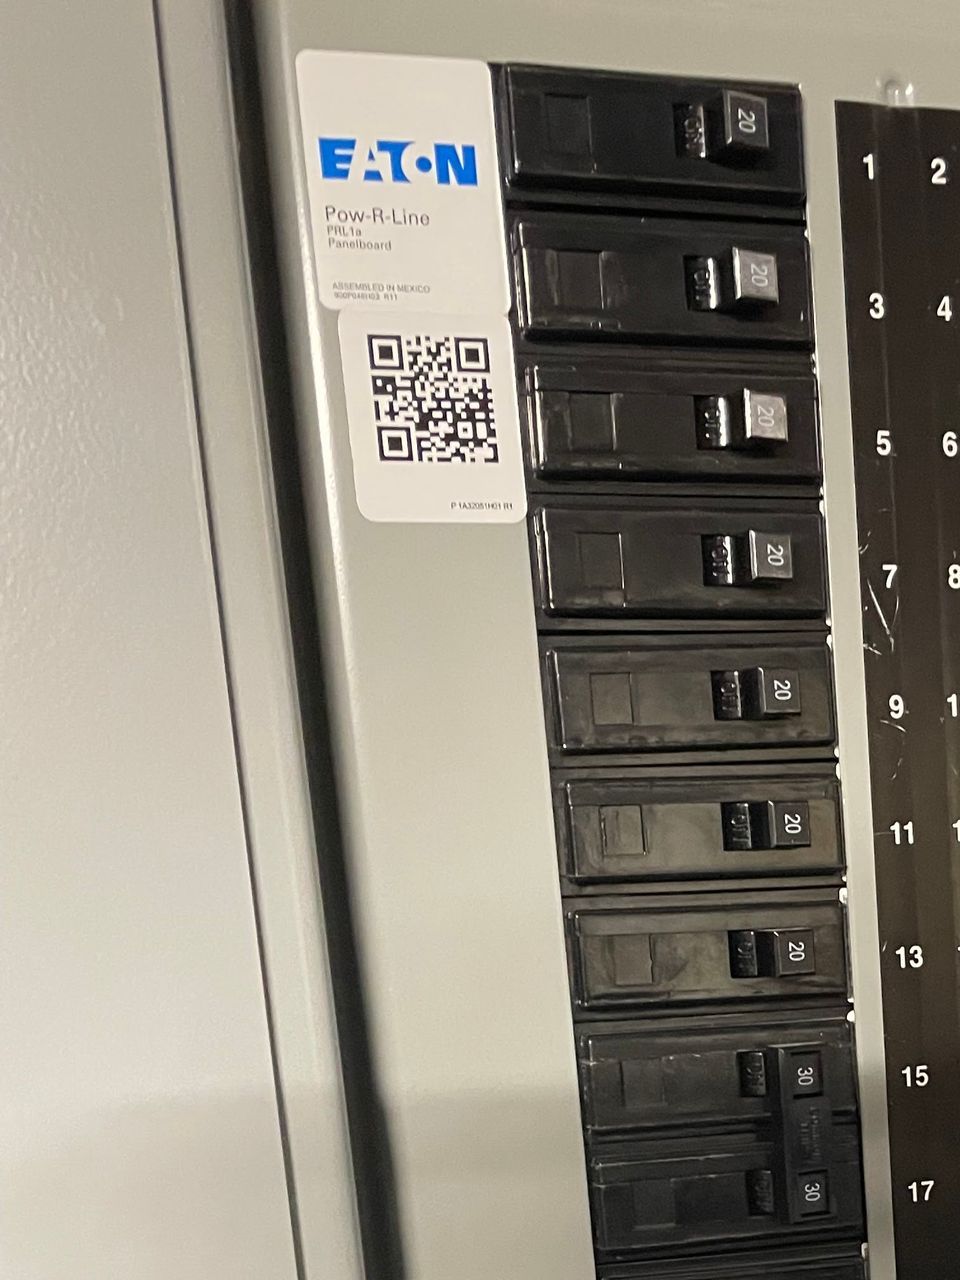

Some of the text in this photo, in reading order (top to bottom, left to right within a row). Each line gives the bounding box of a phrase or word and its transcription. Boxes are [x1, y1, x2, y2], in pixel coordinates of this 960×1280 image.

[737, 107, 757, 134] 20
[317, 137, 479, 187] EATON
[862, 153, 875, 180] 1
[930, 157, 947, 185] 2
[325, 205, 430, 226] Pow-R-Line
[326, 225, 362, 237] PRL1a
[328, 237, 392, 251] Panelboard
[750, 262, 769, 288] 20
[332, 282, 431, 294] ASSEMBLED IN MEXICO
[869, 292, 885, 320] 3
[936, 295, 953, 322] 4
[757, 404, 775, 428] 20
[876, 429, 892, 456] 5
[942, 430, 959, 458] 6
[766, 543, 785, 567] 20
[882, 563, 898, 589] 7
[773, 679, 792, 702] 20
[888, 694, 905, 720] 9
[784, 813, 802, 835] 20
[889, 820, 915, 845] 11
[788, 941, 806, 962] 20
[895, 945, 924, 969] 13
[797, 1066, 815, 1086] 30
[901, 1064, 929, 1088] 15
[804, 1182, 821, 1202] 30
[907, 1180, 935, 1203] 17
